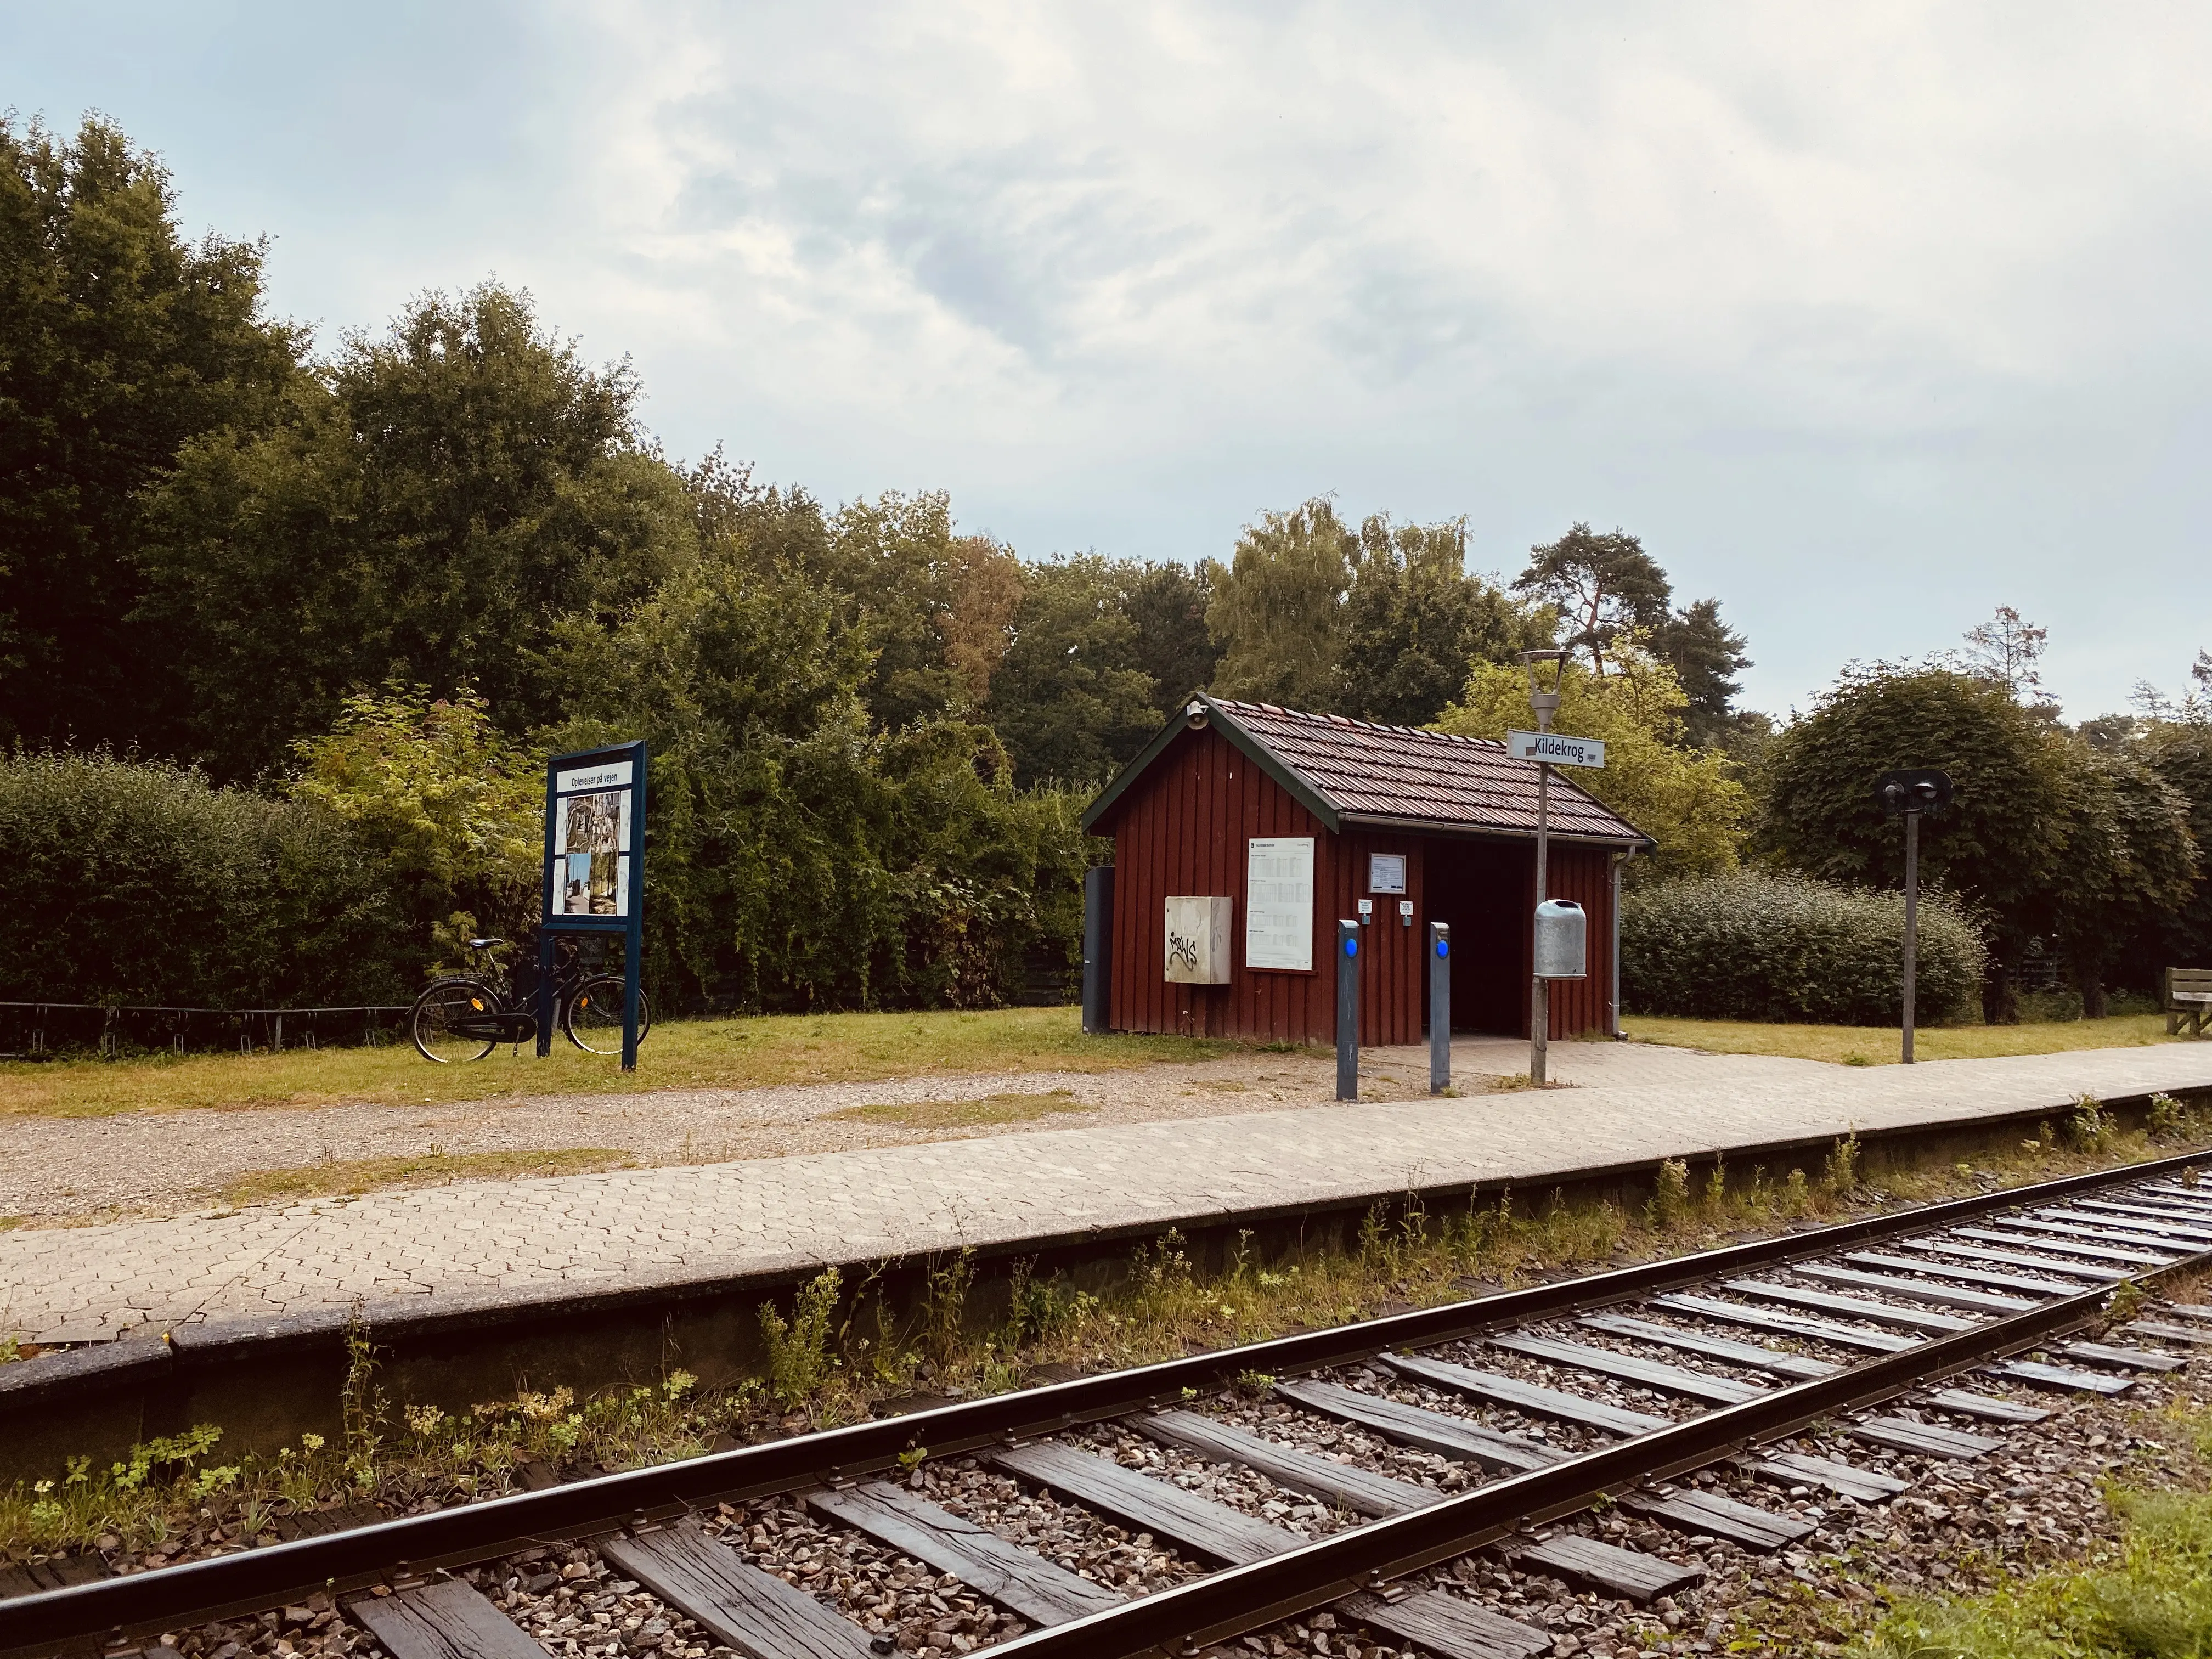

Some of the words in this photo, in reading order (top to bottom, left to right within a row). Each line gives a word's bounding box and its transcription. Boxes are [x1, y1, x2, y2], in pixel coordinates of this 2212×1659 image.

[1535, 738, 1584, 763] Kildekrog
[572, 775, 596, 788] Oplevelser
[597, 772, 602, 786] på
[604, 772, 617, 785] vejen
